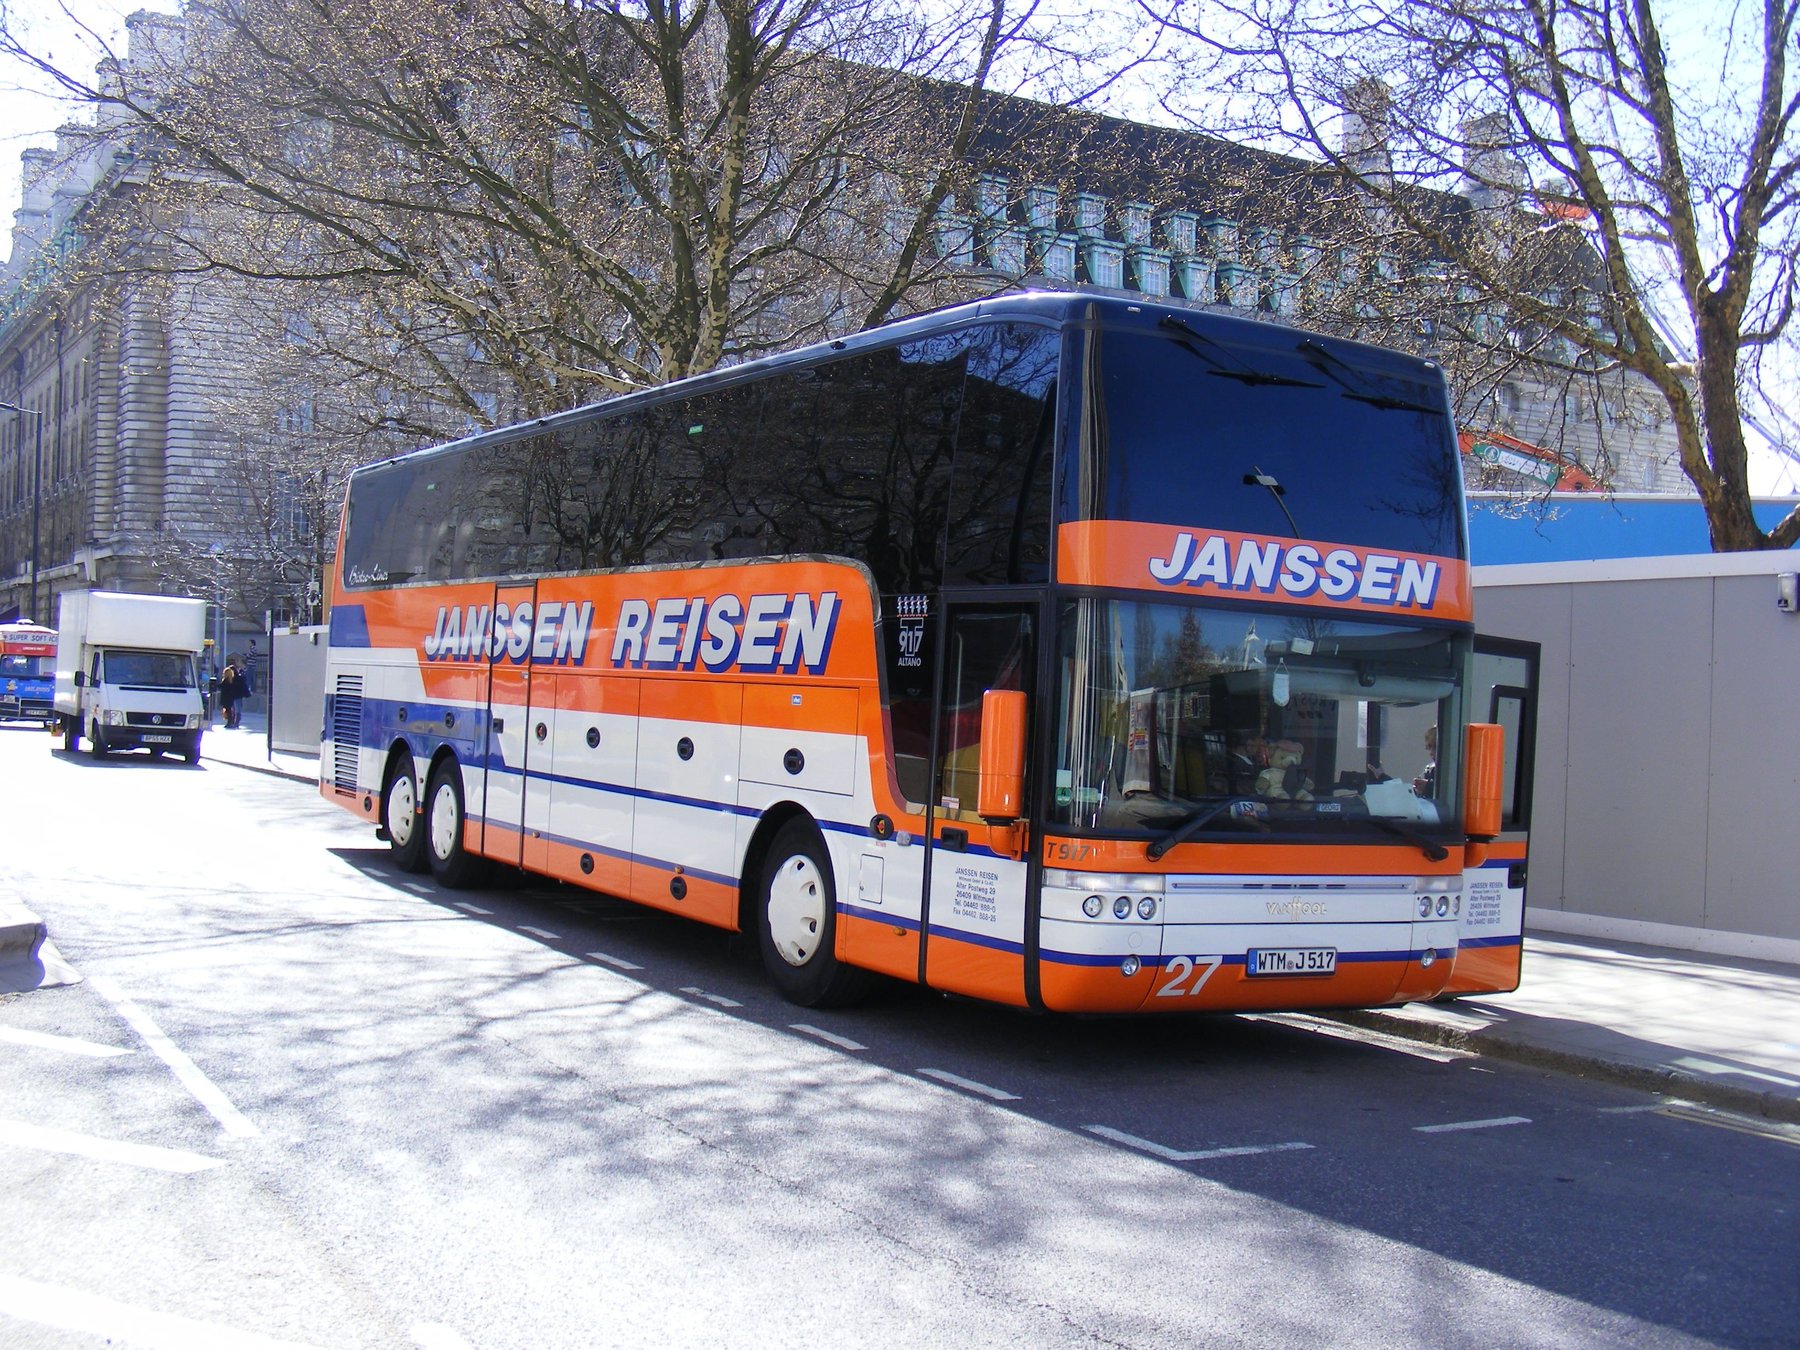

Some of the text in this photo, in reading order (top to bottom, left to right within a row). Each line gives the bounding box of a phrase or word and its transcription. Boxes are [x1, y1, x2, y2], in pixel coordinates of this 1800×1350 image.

[1148, 532, 1441, 609] JANSSEN
[424, 592, 843, 675] JANSSEN REISEN
[898, 657, 922, 666] ALTANO
[956, 868, 998, 880] JANSSEN REISEN
[1258, 952, 1286, 970] WTM
[1156, 956, 1223, 997] 27
